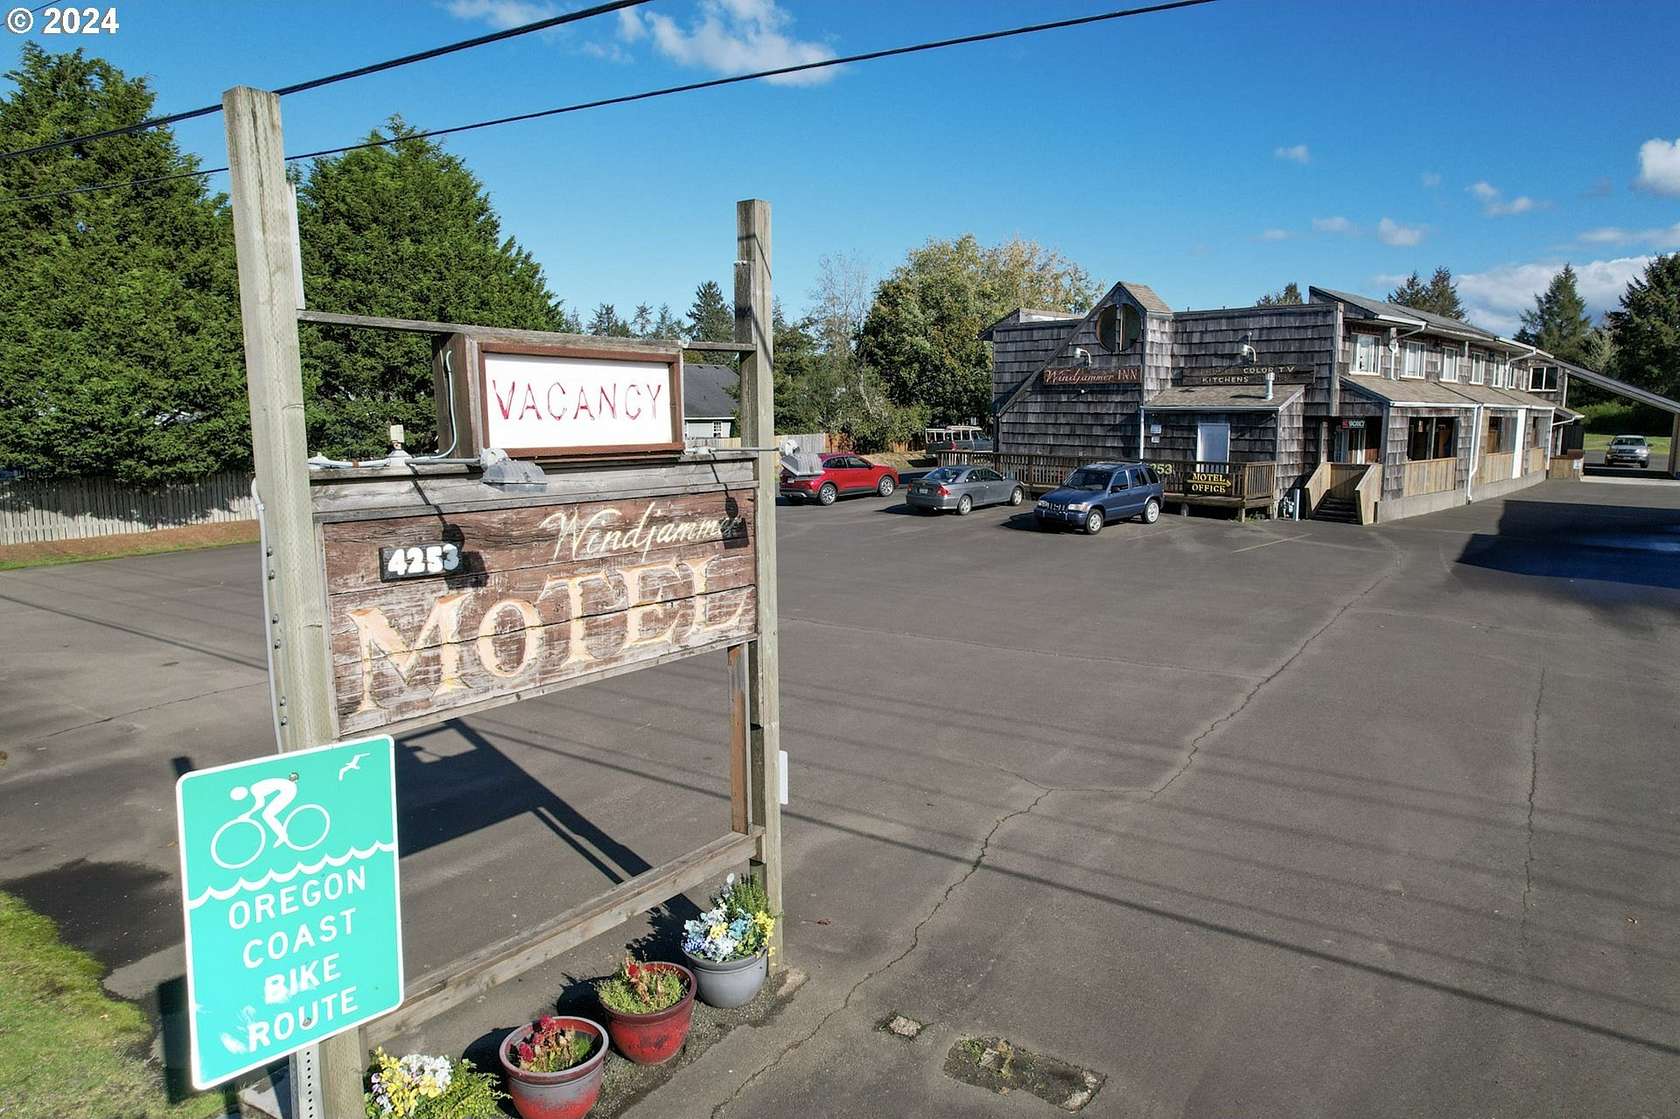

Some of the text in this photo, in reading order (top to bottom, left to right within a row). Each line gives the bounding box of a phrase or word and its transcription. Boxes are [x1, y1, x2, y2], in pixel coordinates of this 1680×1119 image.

[1045, 367, 1138, 385] Windjammer INN
[1243, 366, 1274, 374] COLOR
[491, 379, 663, 422] VACANCY
[1191, 483, 1226, 493] OFFICE
[1192, 473, 1226, 482] MOTEL
[538, 501, 743, 563] Windjammer
[386, 543, 460, 577] 4253
[345, 554, 755, 716] MOTEL
[228, 865, 367, 931] OREGON
[242, 907, 357, 969] COAST
[263, 952, 342, 1005] BIKE
[247, 985, 360, 1053] ROUTE
